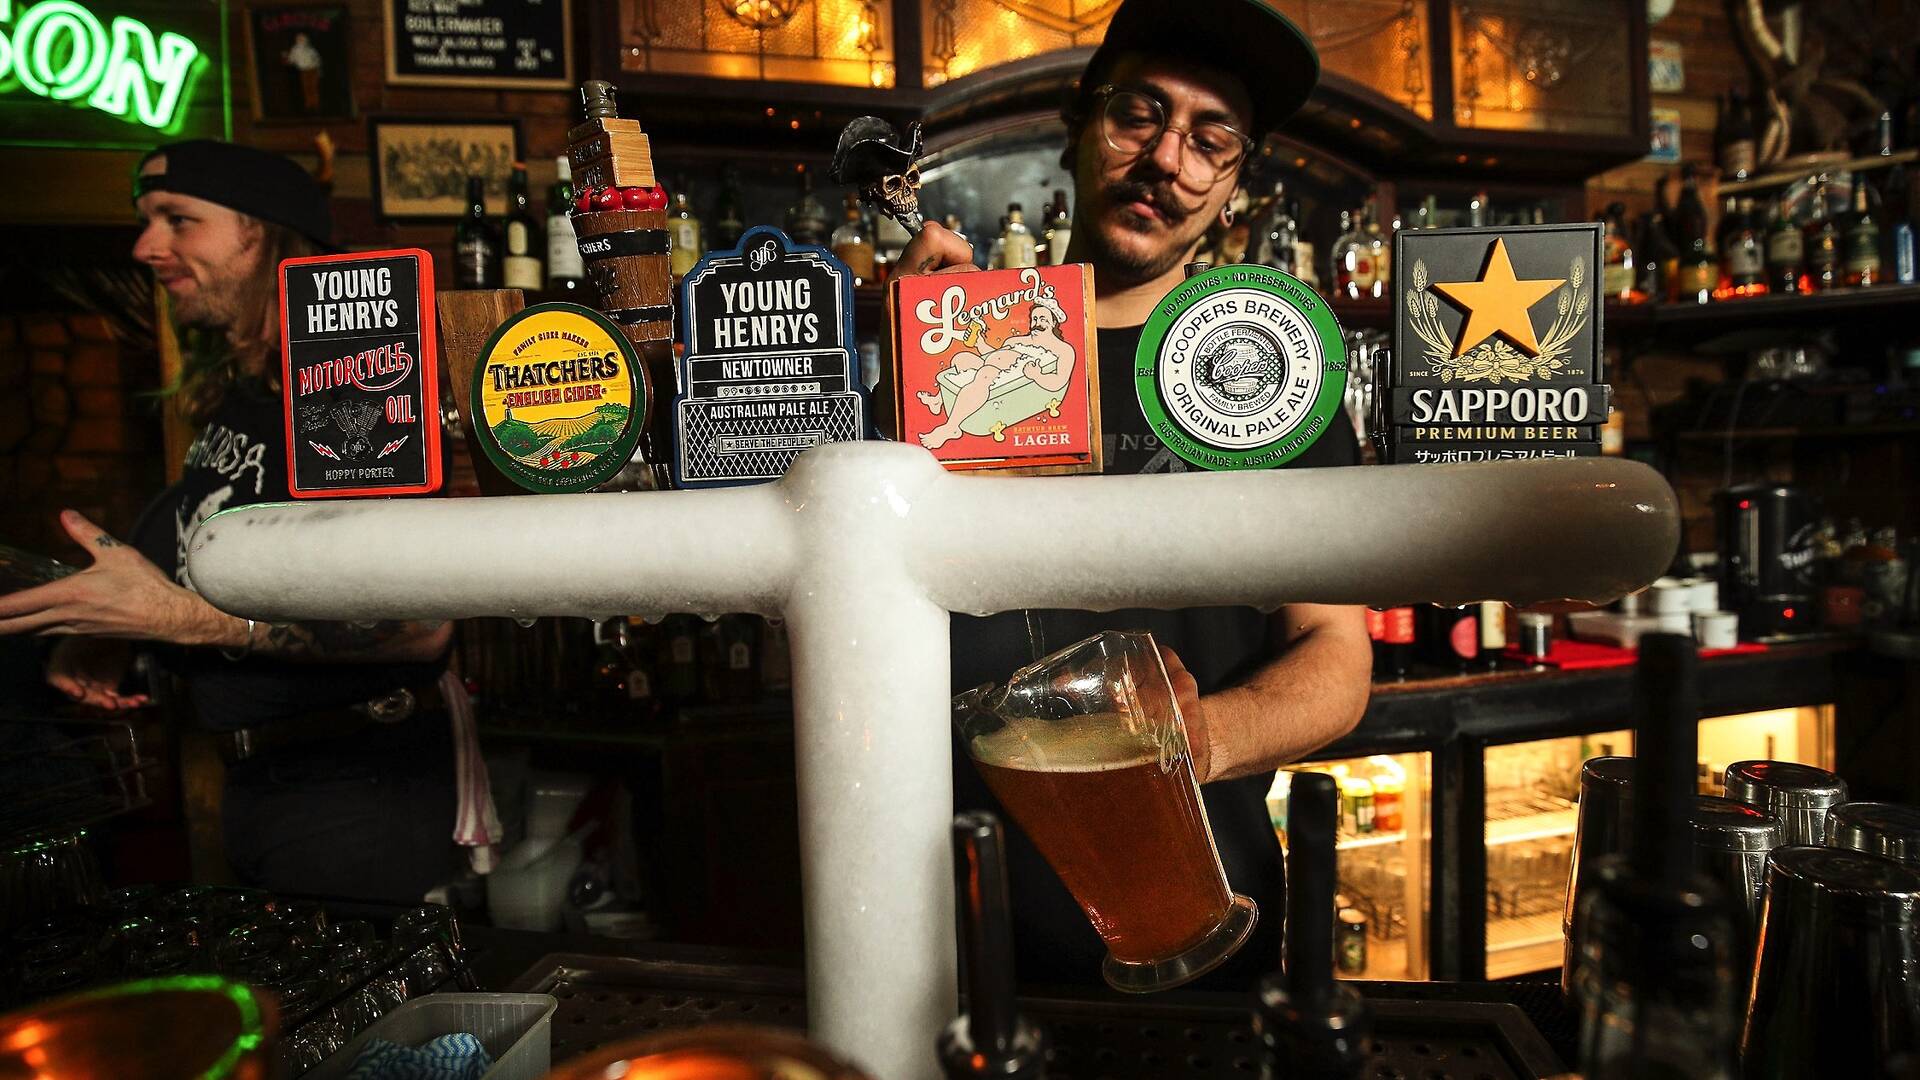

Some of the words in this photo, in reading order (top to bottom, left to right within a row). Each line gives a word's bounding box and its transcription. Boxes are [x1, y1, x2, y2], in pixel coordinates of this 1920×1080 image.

[405, 14, 504, 35] BOILERMAKER
[0, 0, 199, 128] ON
[312, 268, 392, 301] YOUNG
[720, 278, 811, 314] YOUNG
[1163, 304, 1177, 317] NO
[1175, 275, 1221, 305] ADDITIVES
[1232, 273, 1247, 282] NO
[1248, 273, 1317, 311] PRESERVATIVES
[307, 299, 398, 334] HENRYS
[915, 267, 1056, 355] Leonard's
[713, 313, 820, 349] HENRYS
[1172, 300, 1238, 364] COOPERS
[1245, 300, 1311, 362] BREWERY
[1204, 331, 1230, 354] BOTTLE
[1231, 329, 1277, 352] FERMENTED
[299, 342, 413, 396] MOTORCYCLE
[488, 352, 619, 393] THATCHERS
[722, 357, 813, 379] NEWTOWNER
[1211, 348, 1269, 381] Coopers
[385, 395, 416, 423] OIL
[507, 388, 562, 409] ENGLISH
[563, 384, 603, 404] CIDER
[710, 402, 776, 420] AUSTRALIAN
[779, 401, 808, 416] PALE
[809, 400, 830, 415] ALE
[1173, 382, 1241, 438] ORIGINAL
[1245, 407, 1291, 437] PALE
[1287, 376, 1310, 412] ALE
[1209, 393, 1236, 410] FAMILY
[1237, 391, 1271, 411] BREWED
[1411, 387, 1589, 423] SAPPORO
[735, 439, 759, 449] SERVE
[760, 438, 777, 448] THE
[778, 437, 806, 447] PEOPLE
[1014, 433, 1071, 446] LAGER
[1158, 421, 1204, 460] AUSTRALIAN
[1204, 452, 1231, 467] MADE
[1243, 440, 1298, 467] AUSTRALIAN
[1297, 415, 1324, 444] OWNED
[1415, 426, 1517, 440] PREMIUM
[1525, 426, 1579, 440] BEER
[325, 468, 357, 481] HOPPY
[359, 467, 395, 479] PORTER
